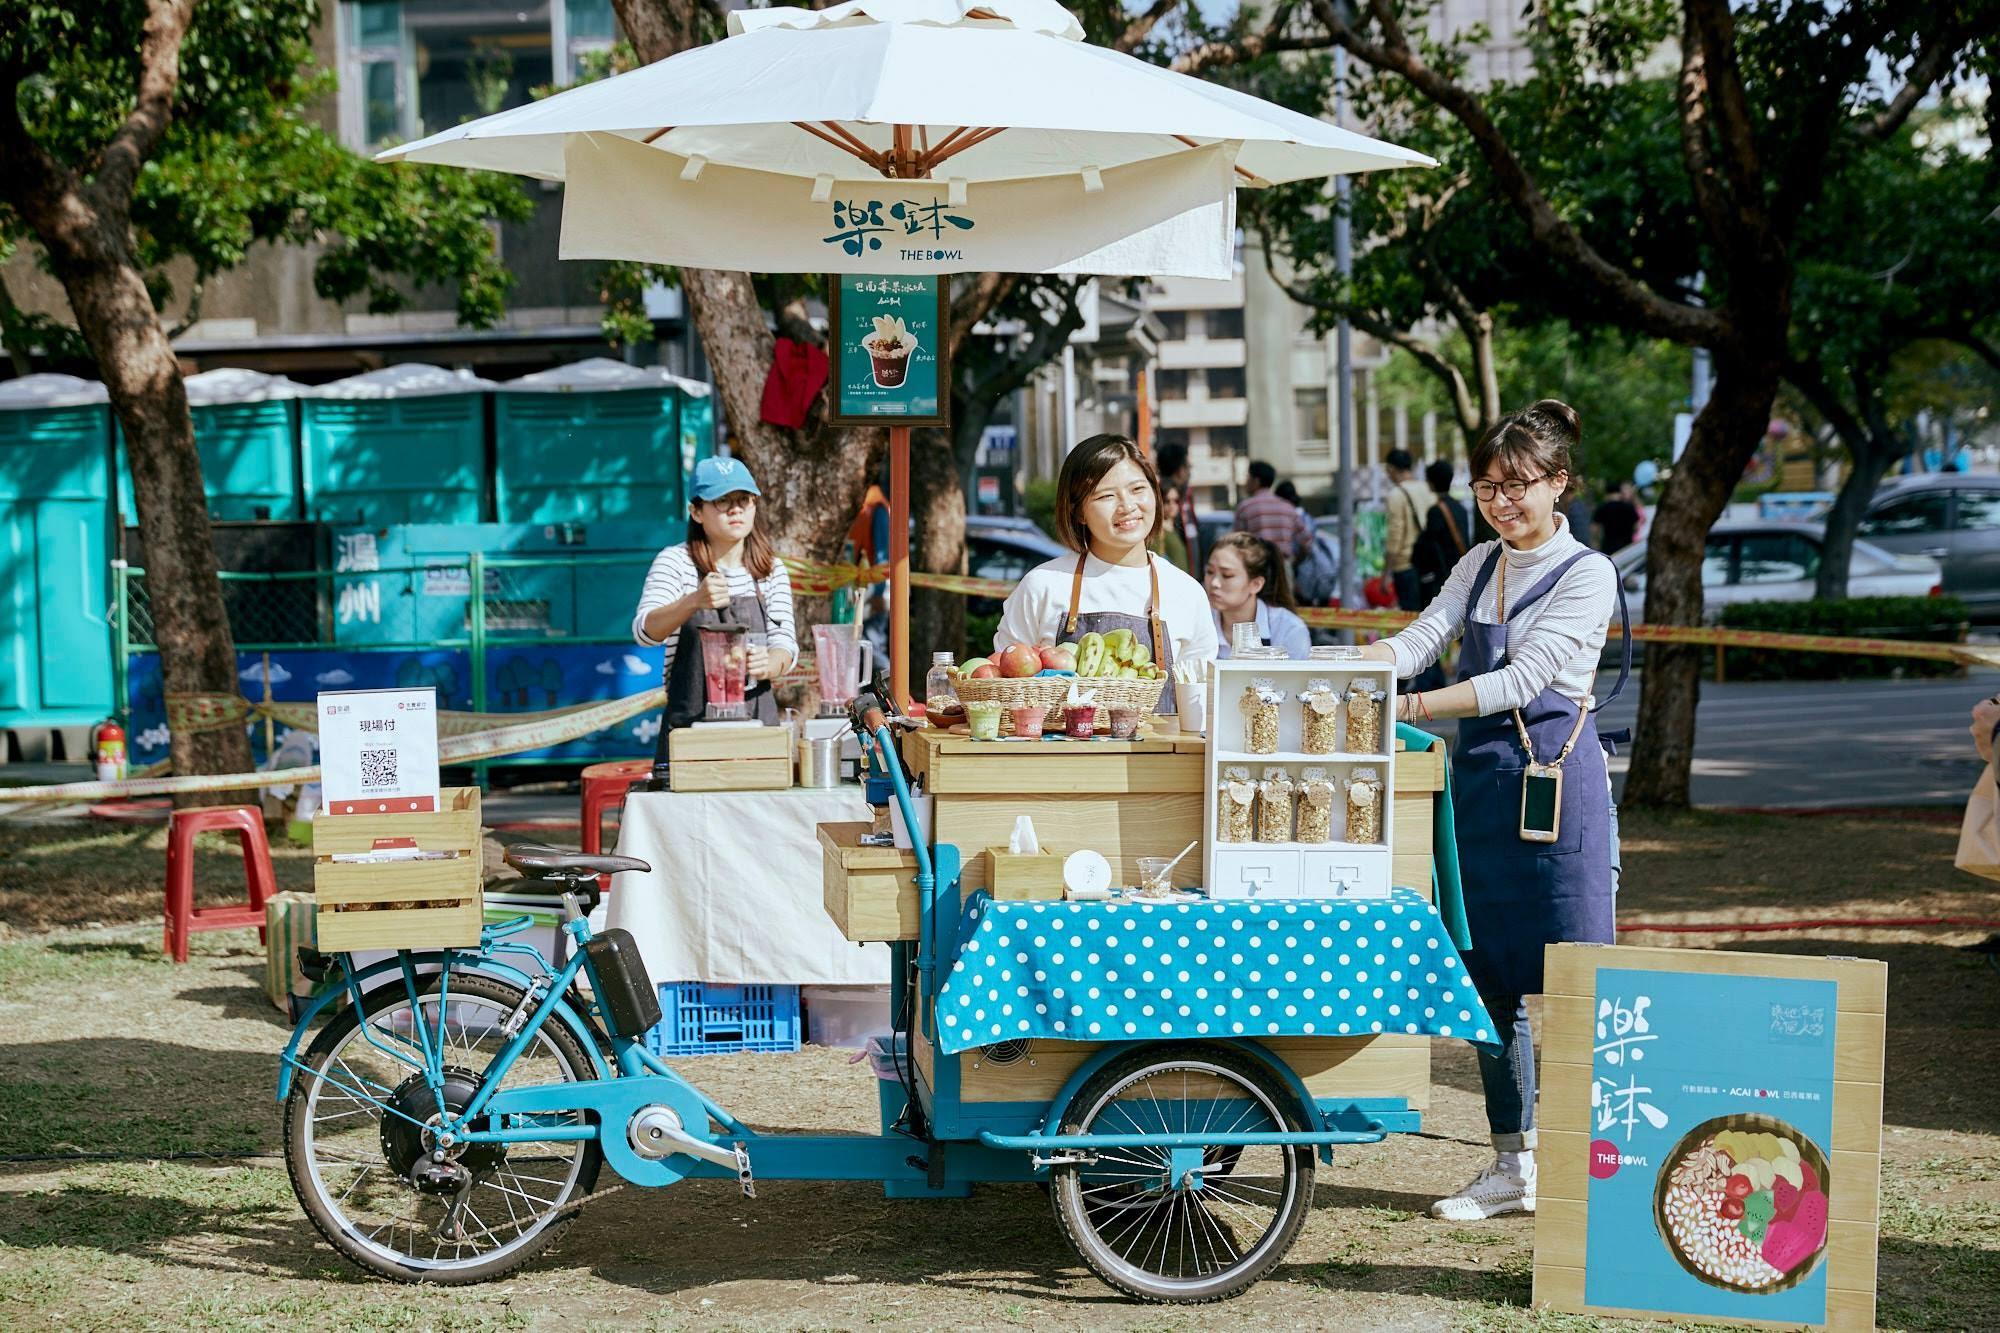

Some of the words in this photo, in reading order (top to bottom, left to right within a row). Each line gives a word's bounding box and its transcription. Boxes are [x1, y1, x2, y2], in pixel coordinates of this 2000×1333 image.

[900, 249, 924, 261] THE
[926, 249, 964, 261] BOWL
[359, 718, 396, 732] 現場付
[1729, 1087, 1751, 1097] ACAI
[1754, 1088, 1780, 1099] BOWL
[1596, 1153, 1615, 1165] THE
[1617, 1154, 1649, 1167] BOWL
